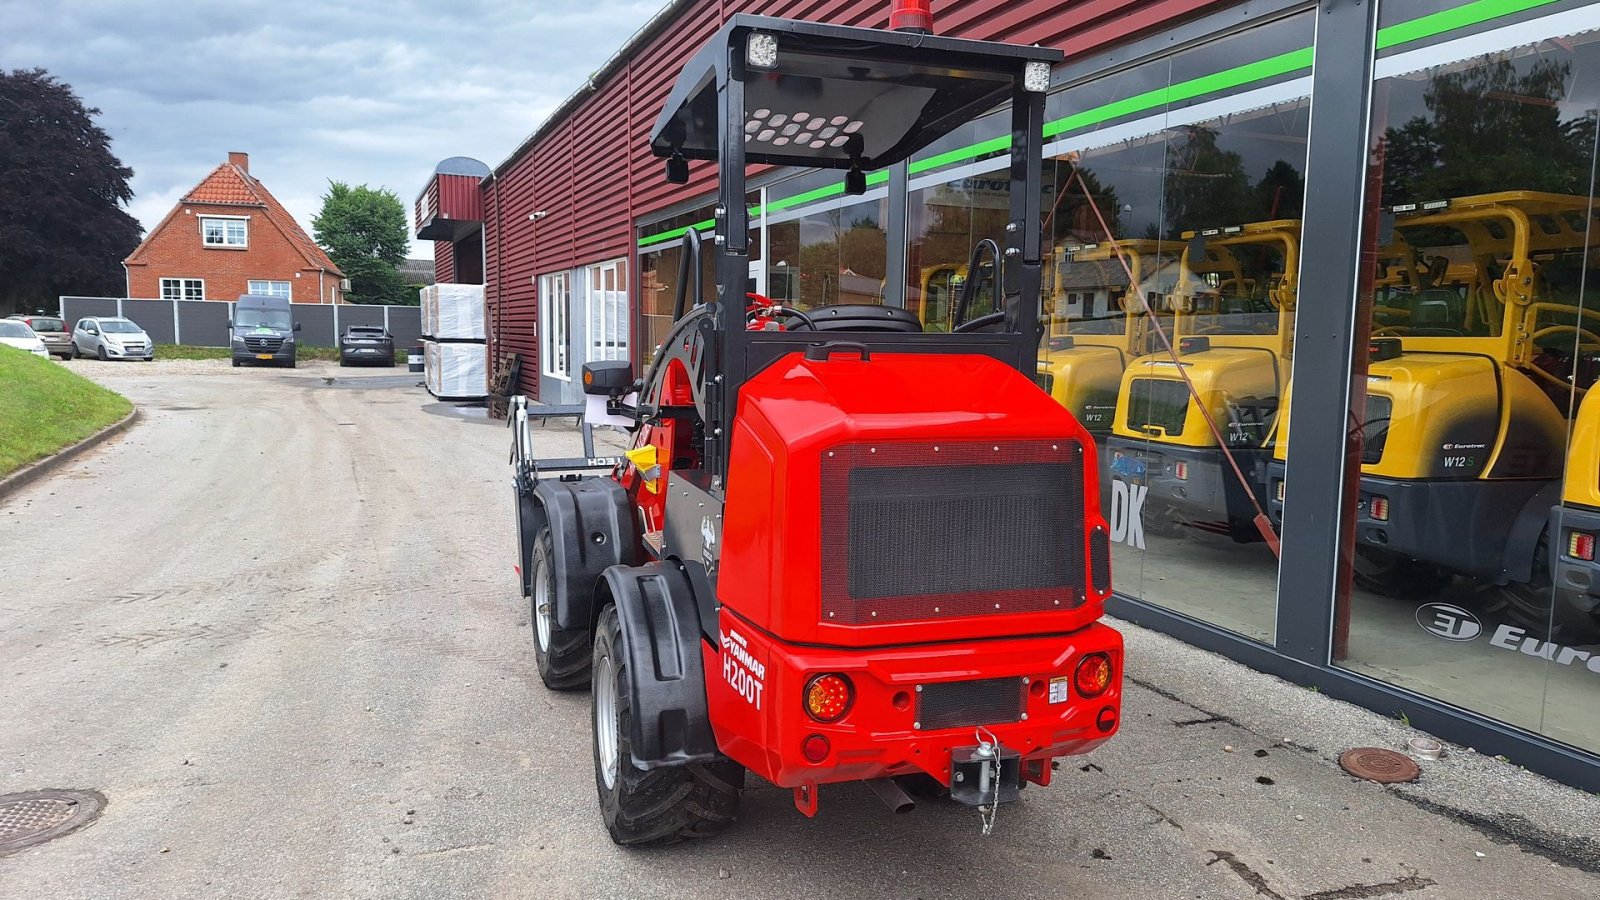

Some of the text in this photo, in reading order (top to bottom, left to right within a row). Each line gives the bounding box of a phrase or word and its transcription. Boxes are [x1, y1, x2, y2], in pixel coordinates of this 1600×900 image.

[1086, 413, 1102, 421] W12
[1229, 432, 1248, 441] W12
[1110, 479, 1149, 550] DK
[730, 638, 766, 681] YANMAR
[723, 652, 763, 711] H200T
